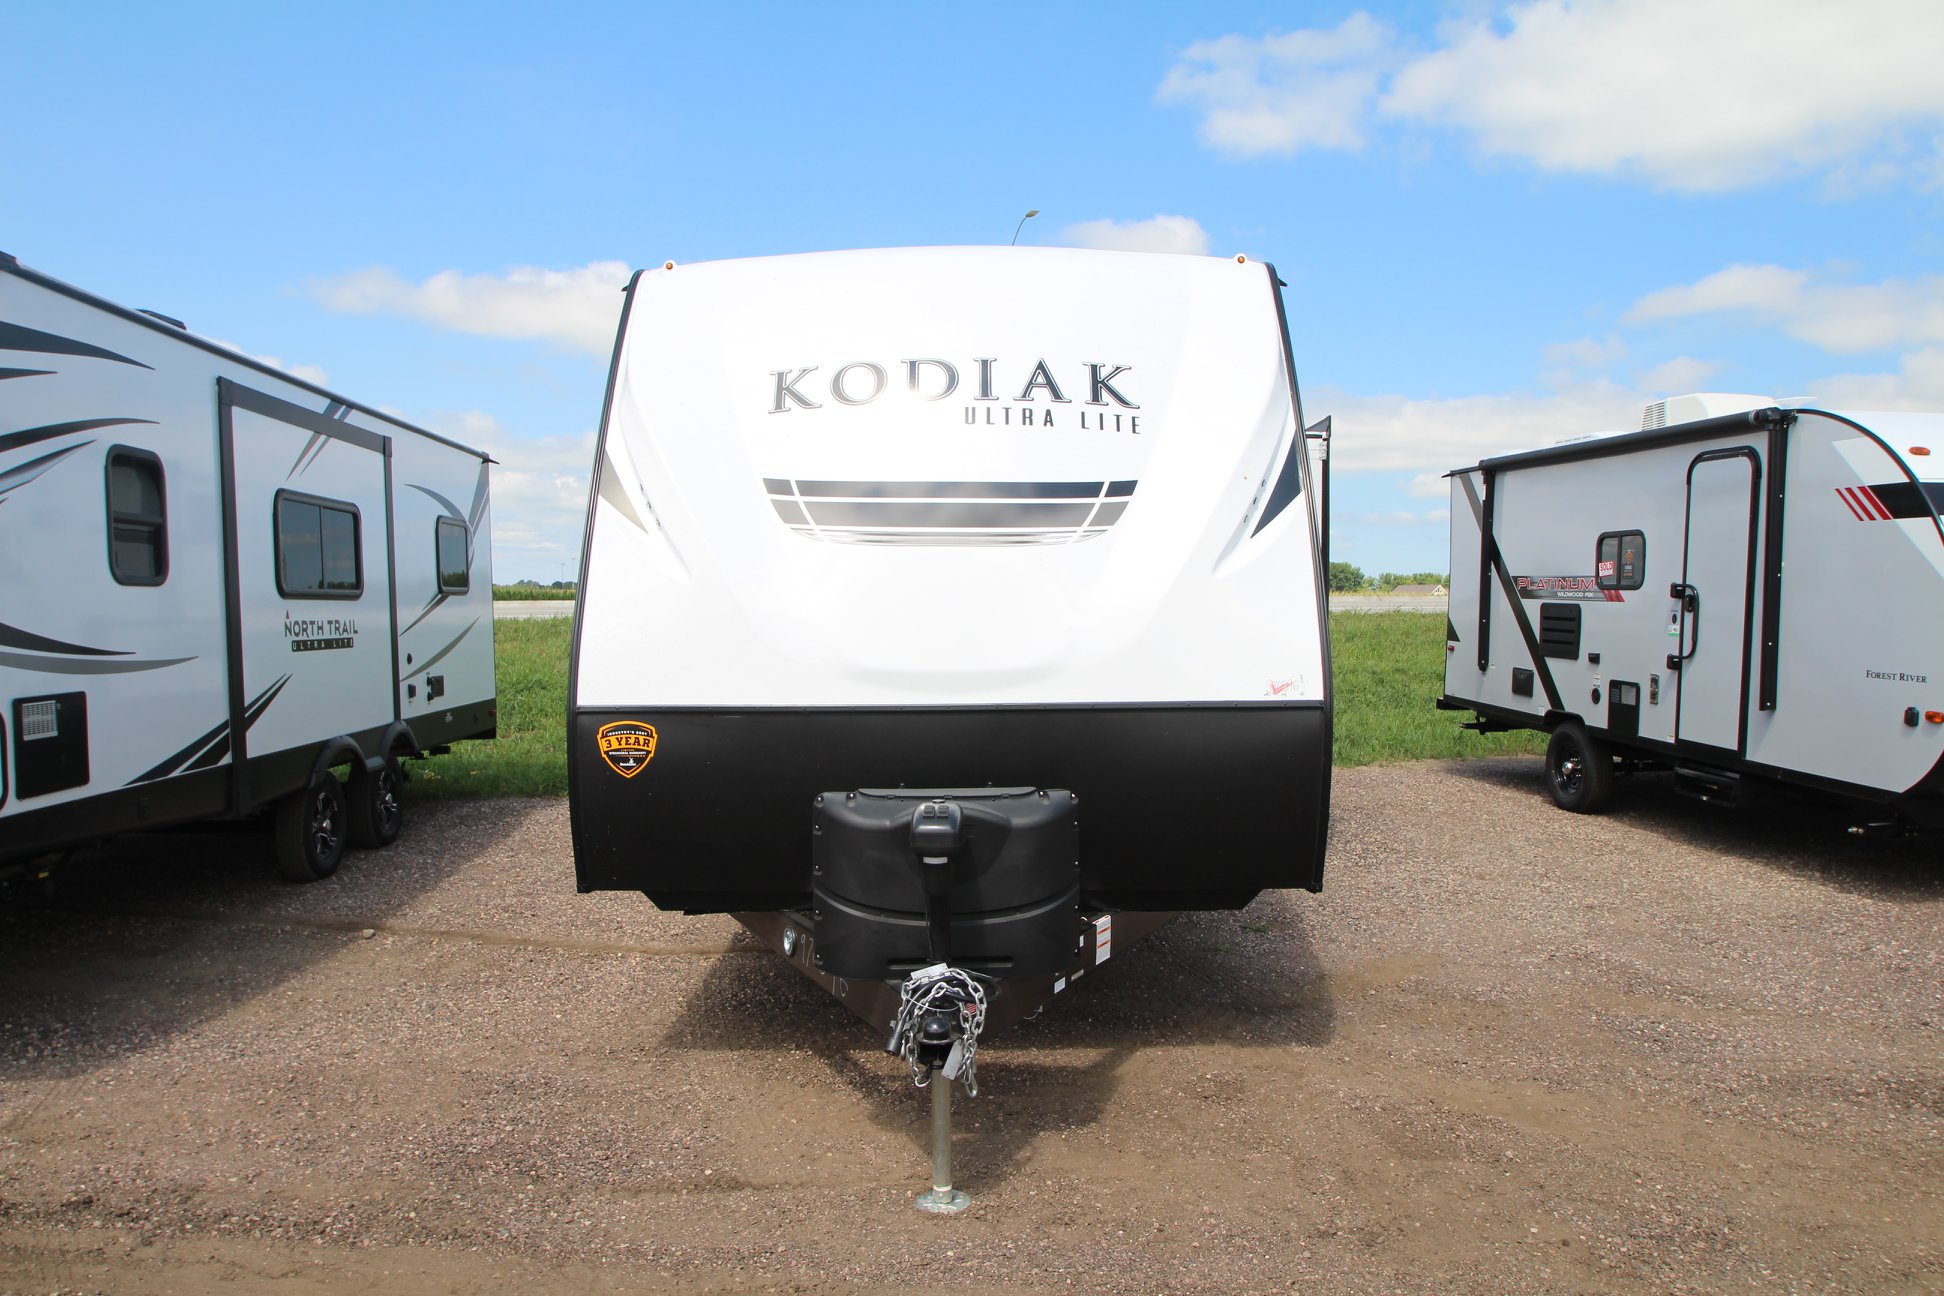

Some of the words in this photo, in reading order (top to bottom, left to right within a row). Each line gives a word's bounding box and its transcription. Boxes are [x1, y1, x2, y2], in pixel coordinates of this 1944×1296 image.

[768, 357, 1140, 414] KODIAK
[964, 406, 1054, 427] ULTRA
[1080, 411, 1141, 434] LITE
[1600, 561, 1613, 571] SOLD
[1517, 577, 1596, 591] PLATINUM
[284, 620, 324, 638] NORTH
[327, 619, 359, 636] TRAIL
[292, 640, 325, 650] ULTRA
[333, 639, 353, 648] LITE
[604, 739, 613, 748] 3
[616, 736, 651, 748] YEAR
